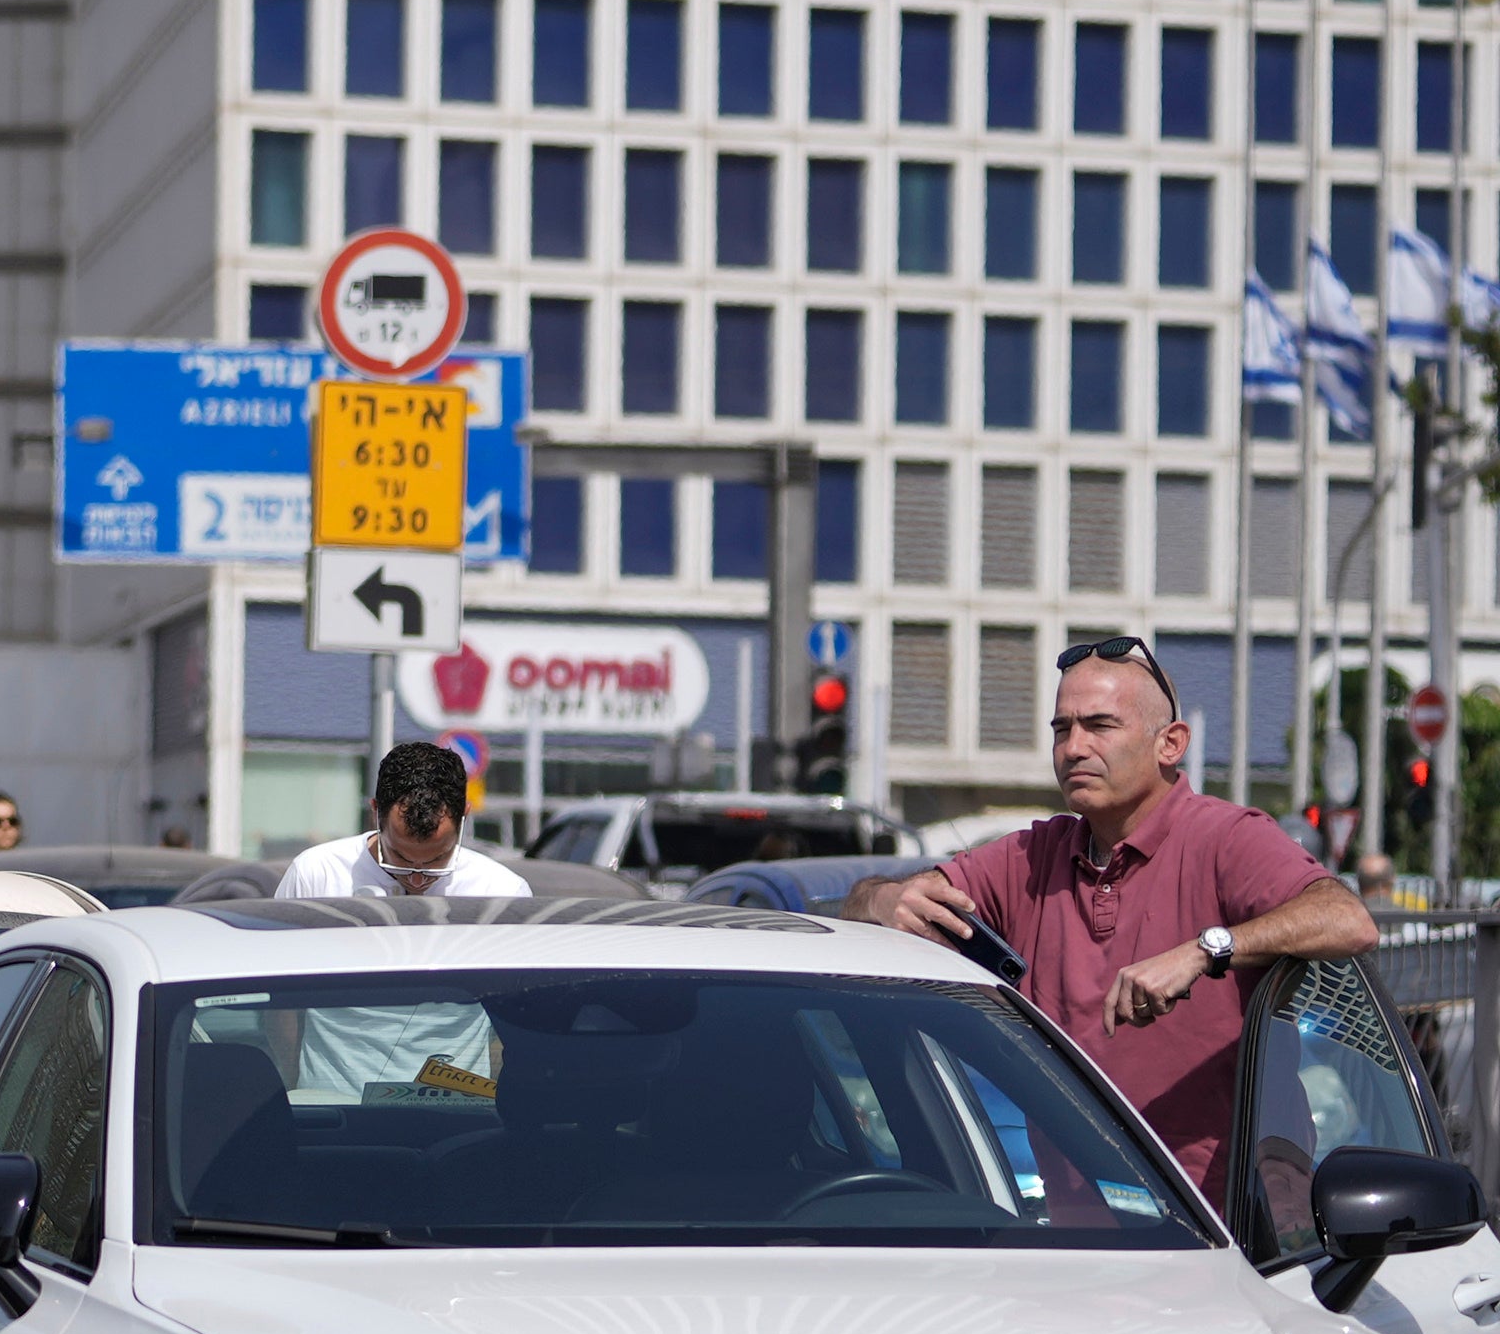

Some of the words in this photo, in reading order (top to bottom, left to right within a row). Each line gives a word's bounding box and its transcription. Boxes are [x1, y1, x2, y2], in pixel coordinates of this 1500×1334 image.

[380, 320, 403, 344] 12
[180, 355, 312, 388] עזריאלי
[181, 397, 293, 428] AZRIELI
[355, 441, 430, 468] 6:30
[376, 479, 407, 499] עד
[203, 491, 227, 541] 2
[352, 505, 428, 535] 9:30
[507, 645, 671, 694] oomai
